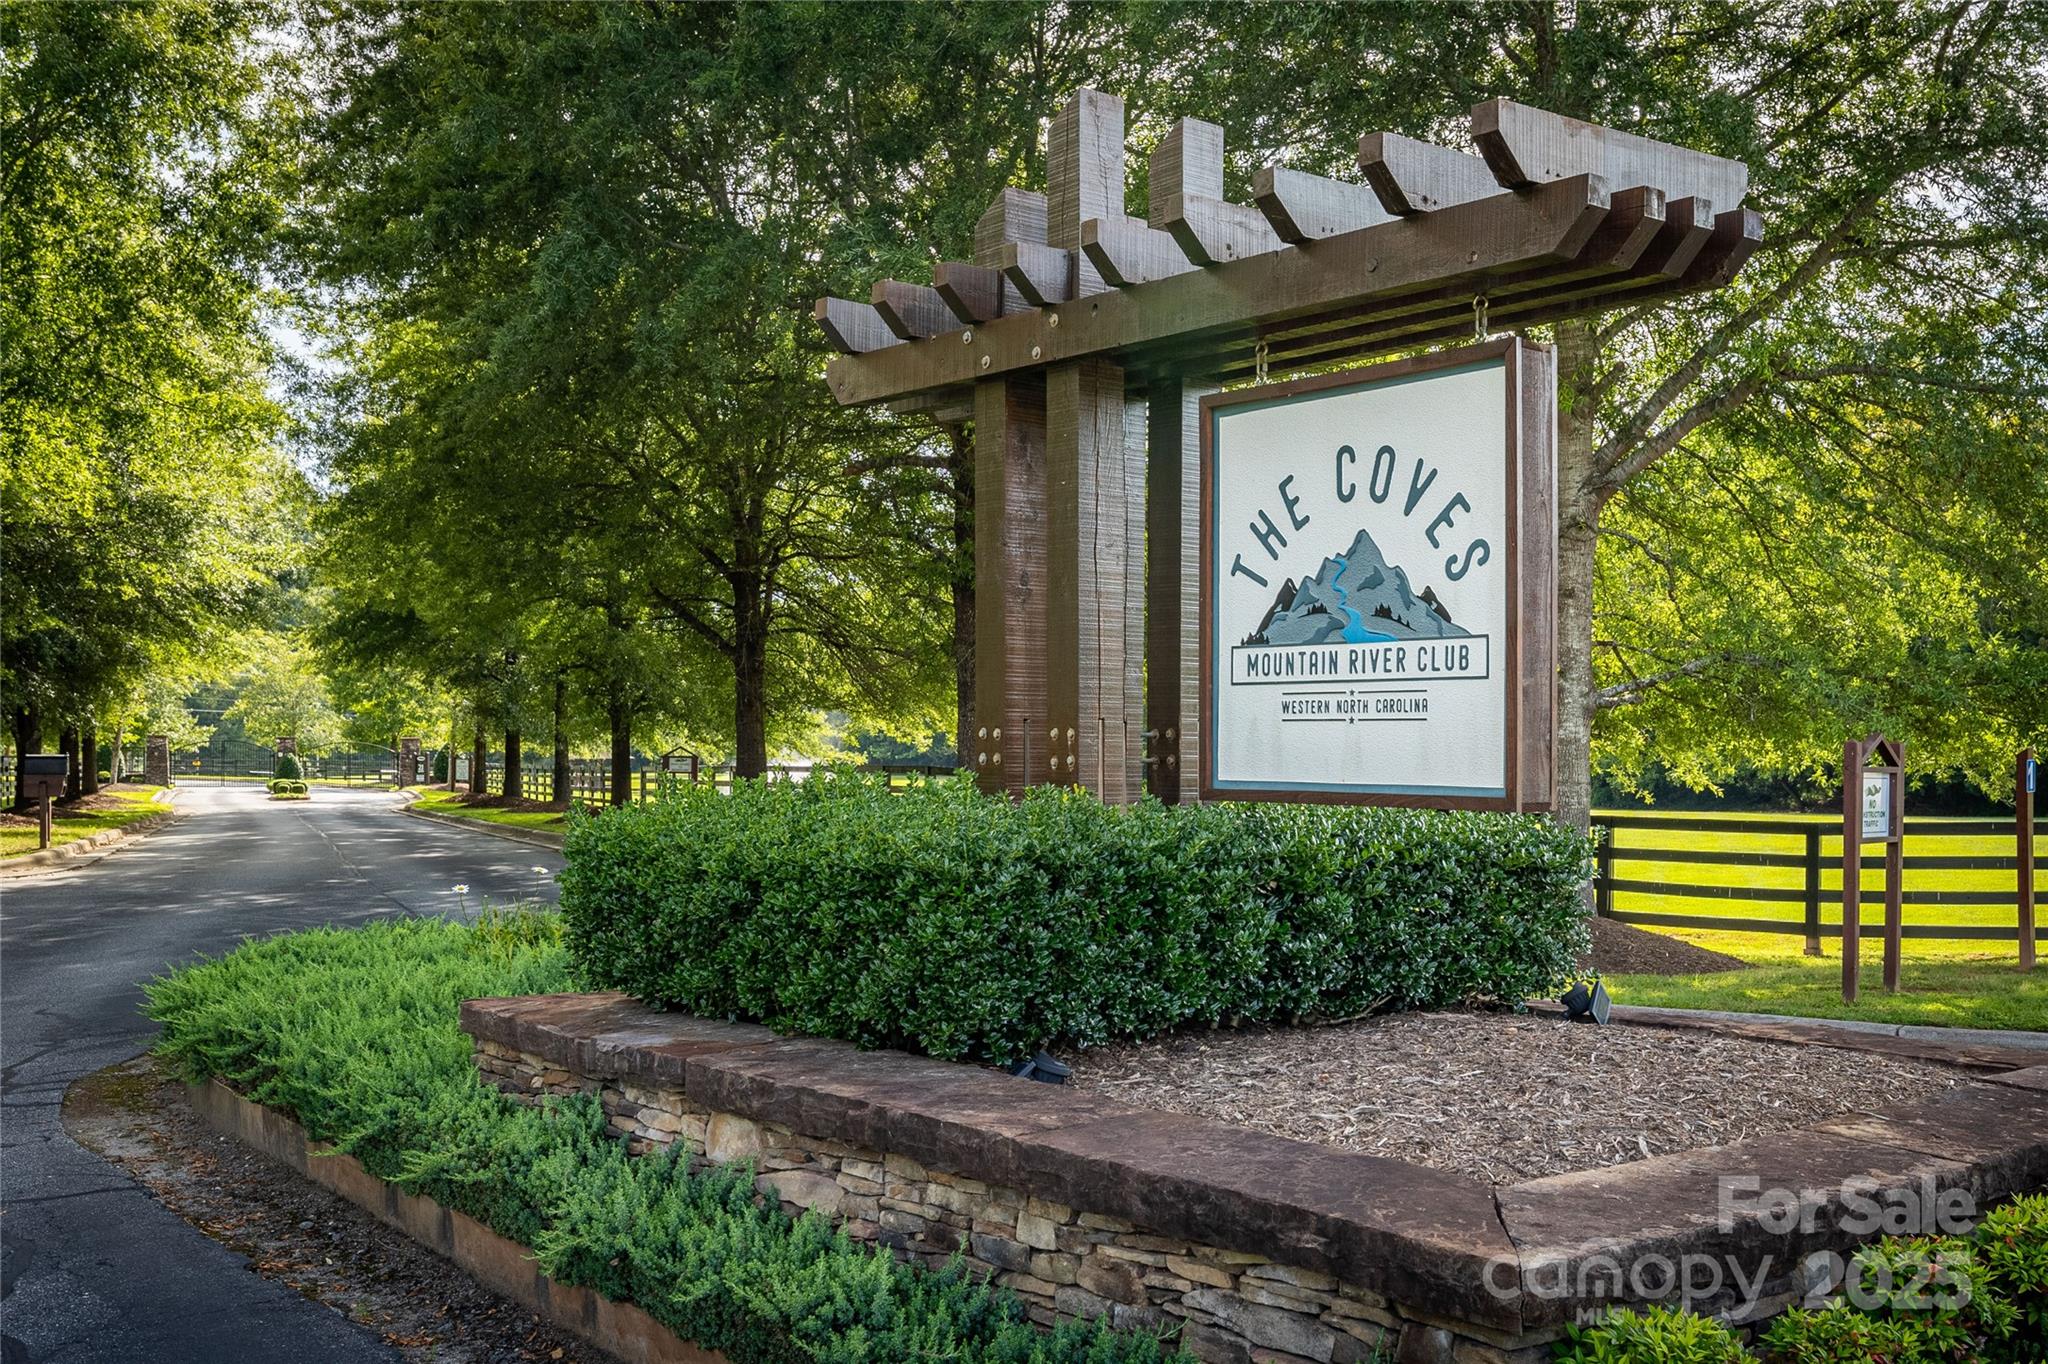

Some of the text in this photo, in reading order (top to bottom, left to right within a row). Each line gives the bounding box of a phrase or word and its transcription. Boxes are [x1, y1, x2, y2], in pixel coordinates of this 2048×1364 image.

[1231, 445, 1491, 588] THE COVES
[1247, 644, 1470, 677] MOUNTAIN RIVER CLUB
[1281, 698, 1428, 714] WESTERN NORTH CAROLINA
